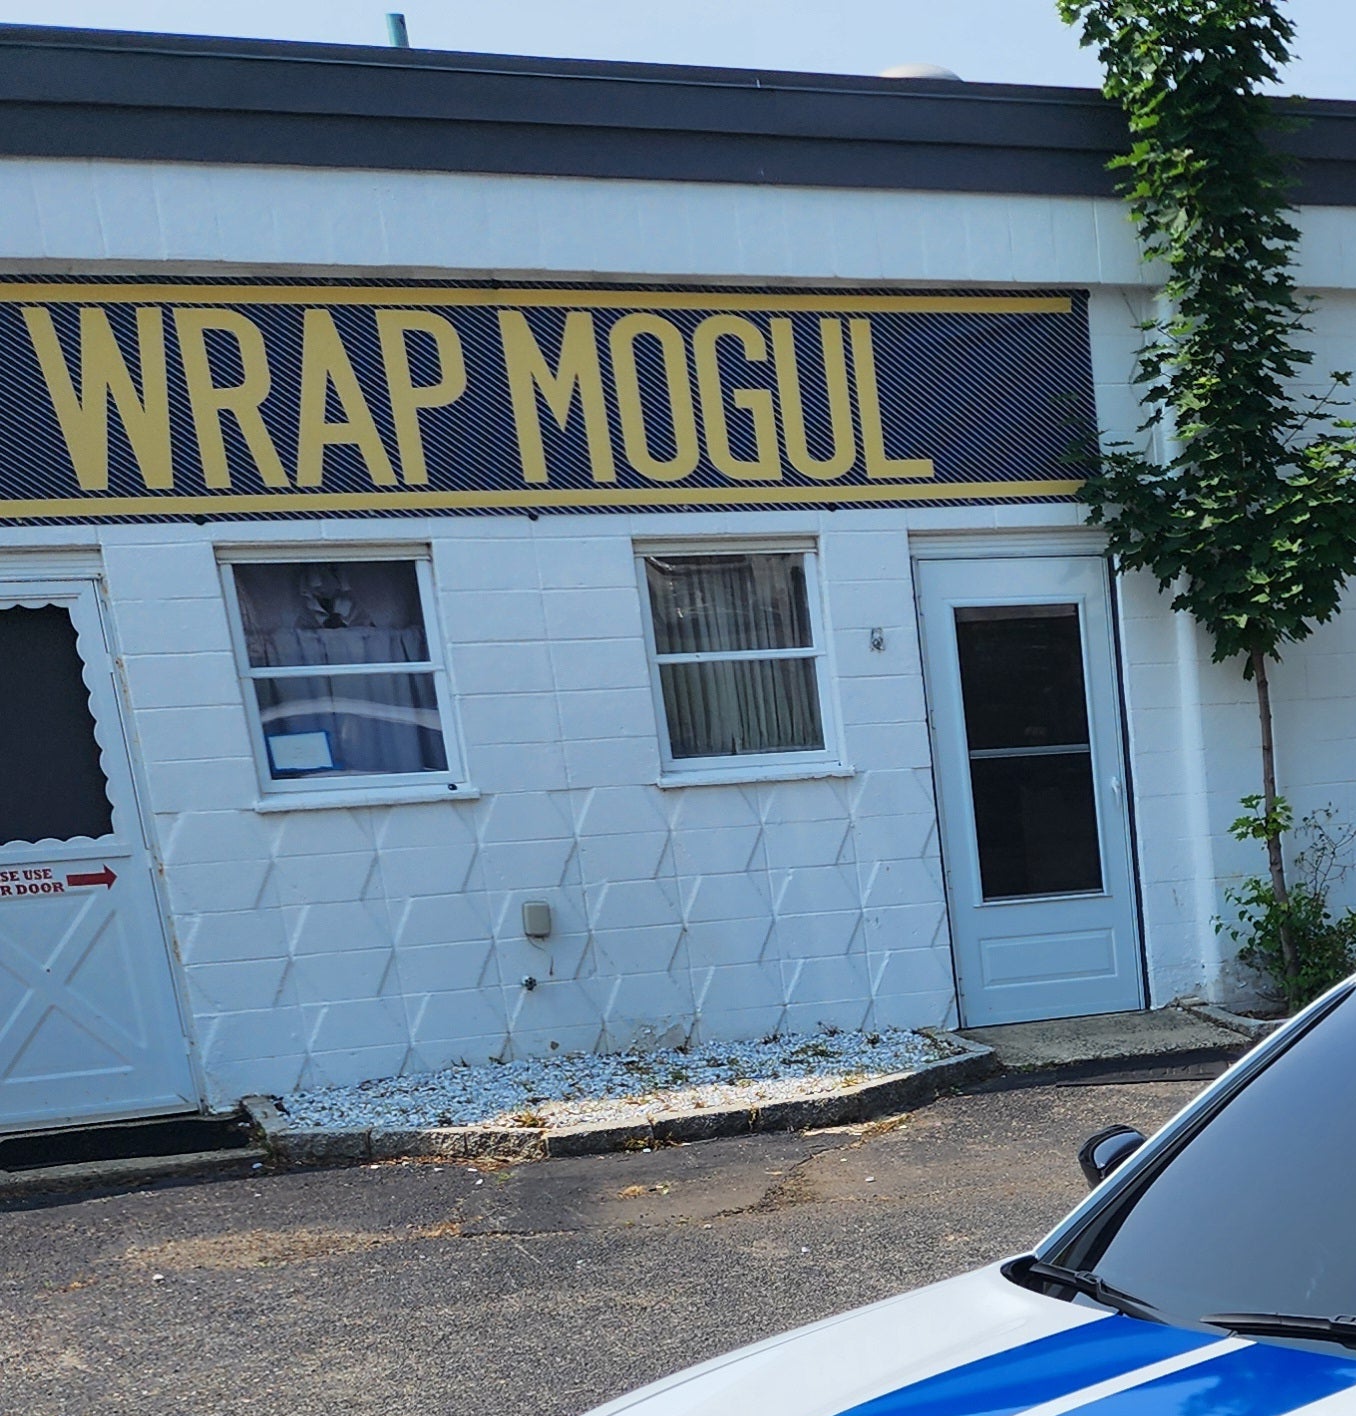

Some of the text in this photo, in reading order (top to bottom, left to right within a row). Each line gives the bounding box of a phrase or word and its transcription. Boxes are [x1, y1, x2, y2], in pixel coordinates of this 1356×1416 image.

[20, 306, 935, 490] WRAP MOGUL
[23, 868, 53, 881] USE
[16, 882, 65, 895] DOOR
